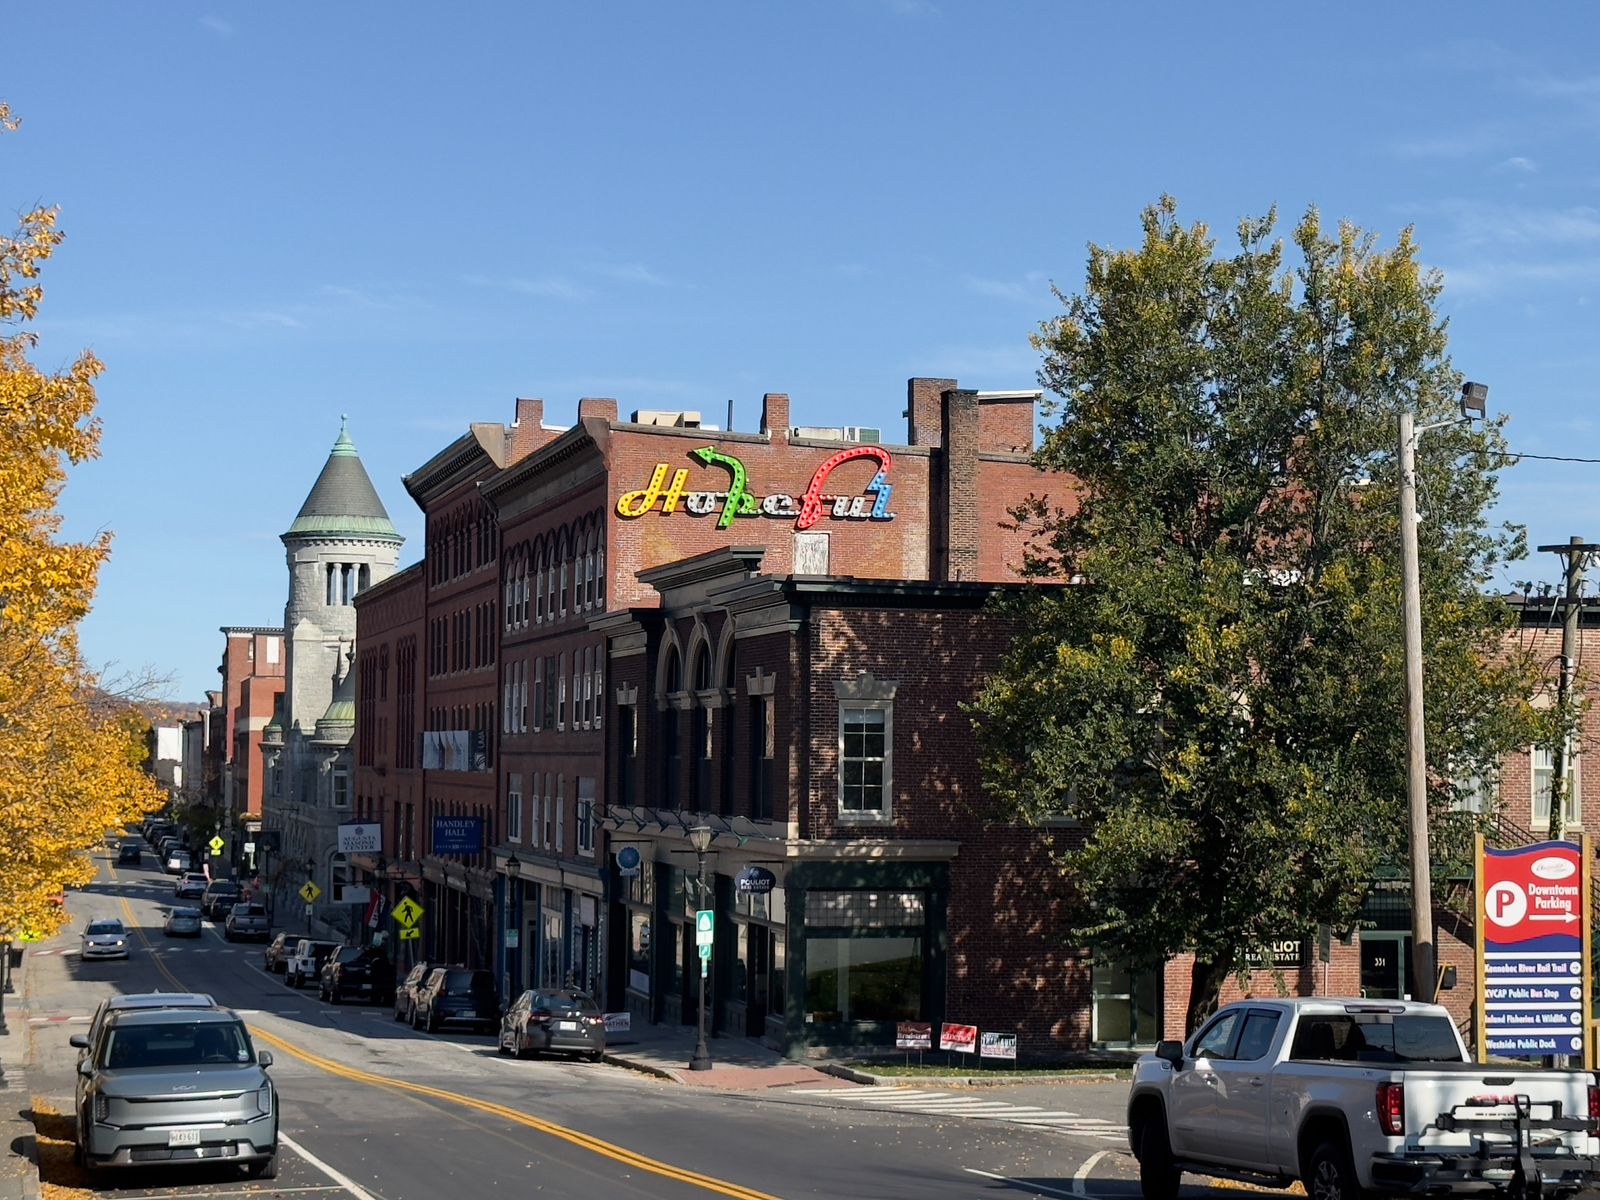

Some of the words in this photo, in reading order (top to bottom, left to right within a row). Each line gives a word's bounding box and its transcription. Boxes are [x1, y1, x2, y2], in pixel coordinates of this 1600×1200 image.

[614, 445, 897, 529] Hopeful
[436, 820, 476, 828] HANDLEY
[444, 828, 467, 837] HALL
[1528, 883, 1578, 896] Downtown
[1495, 889, 1516, 918] P
[1535, 896, 1572, 911] Parking
[1484, 963, 1517, 973] Kennebec
[1518, 963, 1536, 973] River
[1537, 963, 1551, 973] Rail
[1551, 963, 1567, 973] Trail
[1508, 988, 1530, 998] Public
[1530, 988, 1543, 998] Bus
[1543, 988, 1559, 999] Stop
[1506, 1014, 1535, 1023] Fisheries
[1535, 1014, 1541, 1023] &
[1541, 1013, 1567, 1023] Wildlife
[1485, 1039, 1516, 1049] Westside
[1517, 1038, 1538, 1049] Public
[1539, 1038, 1556, 1049] Dock
